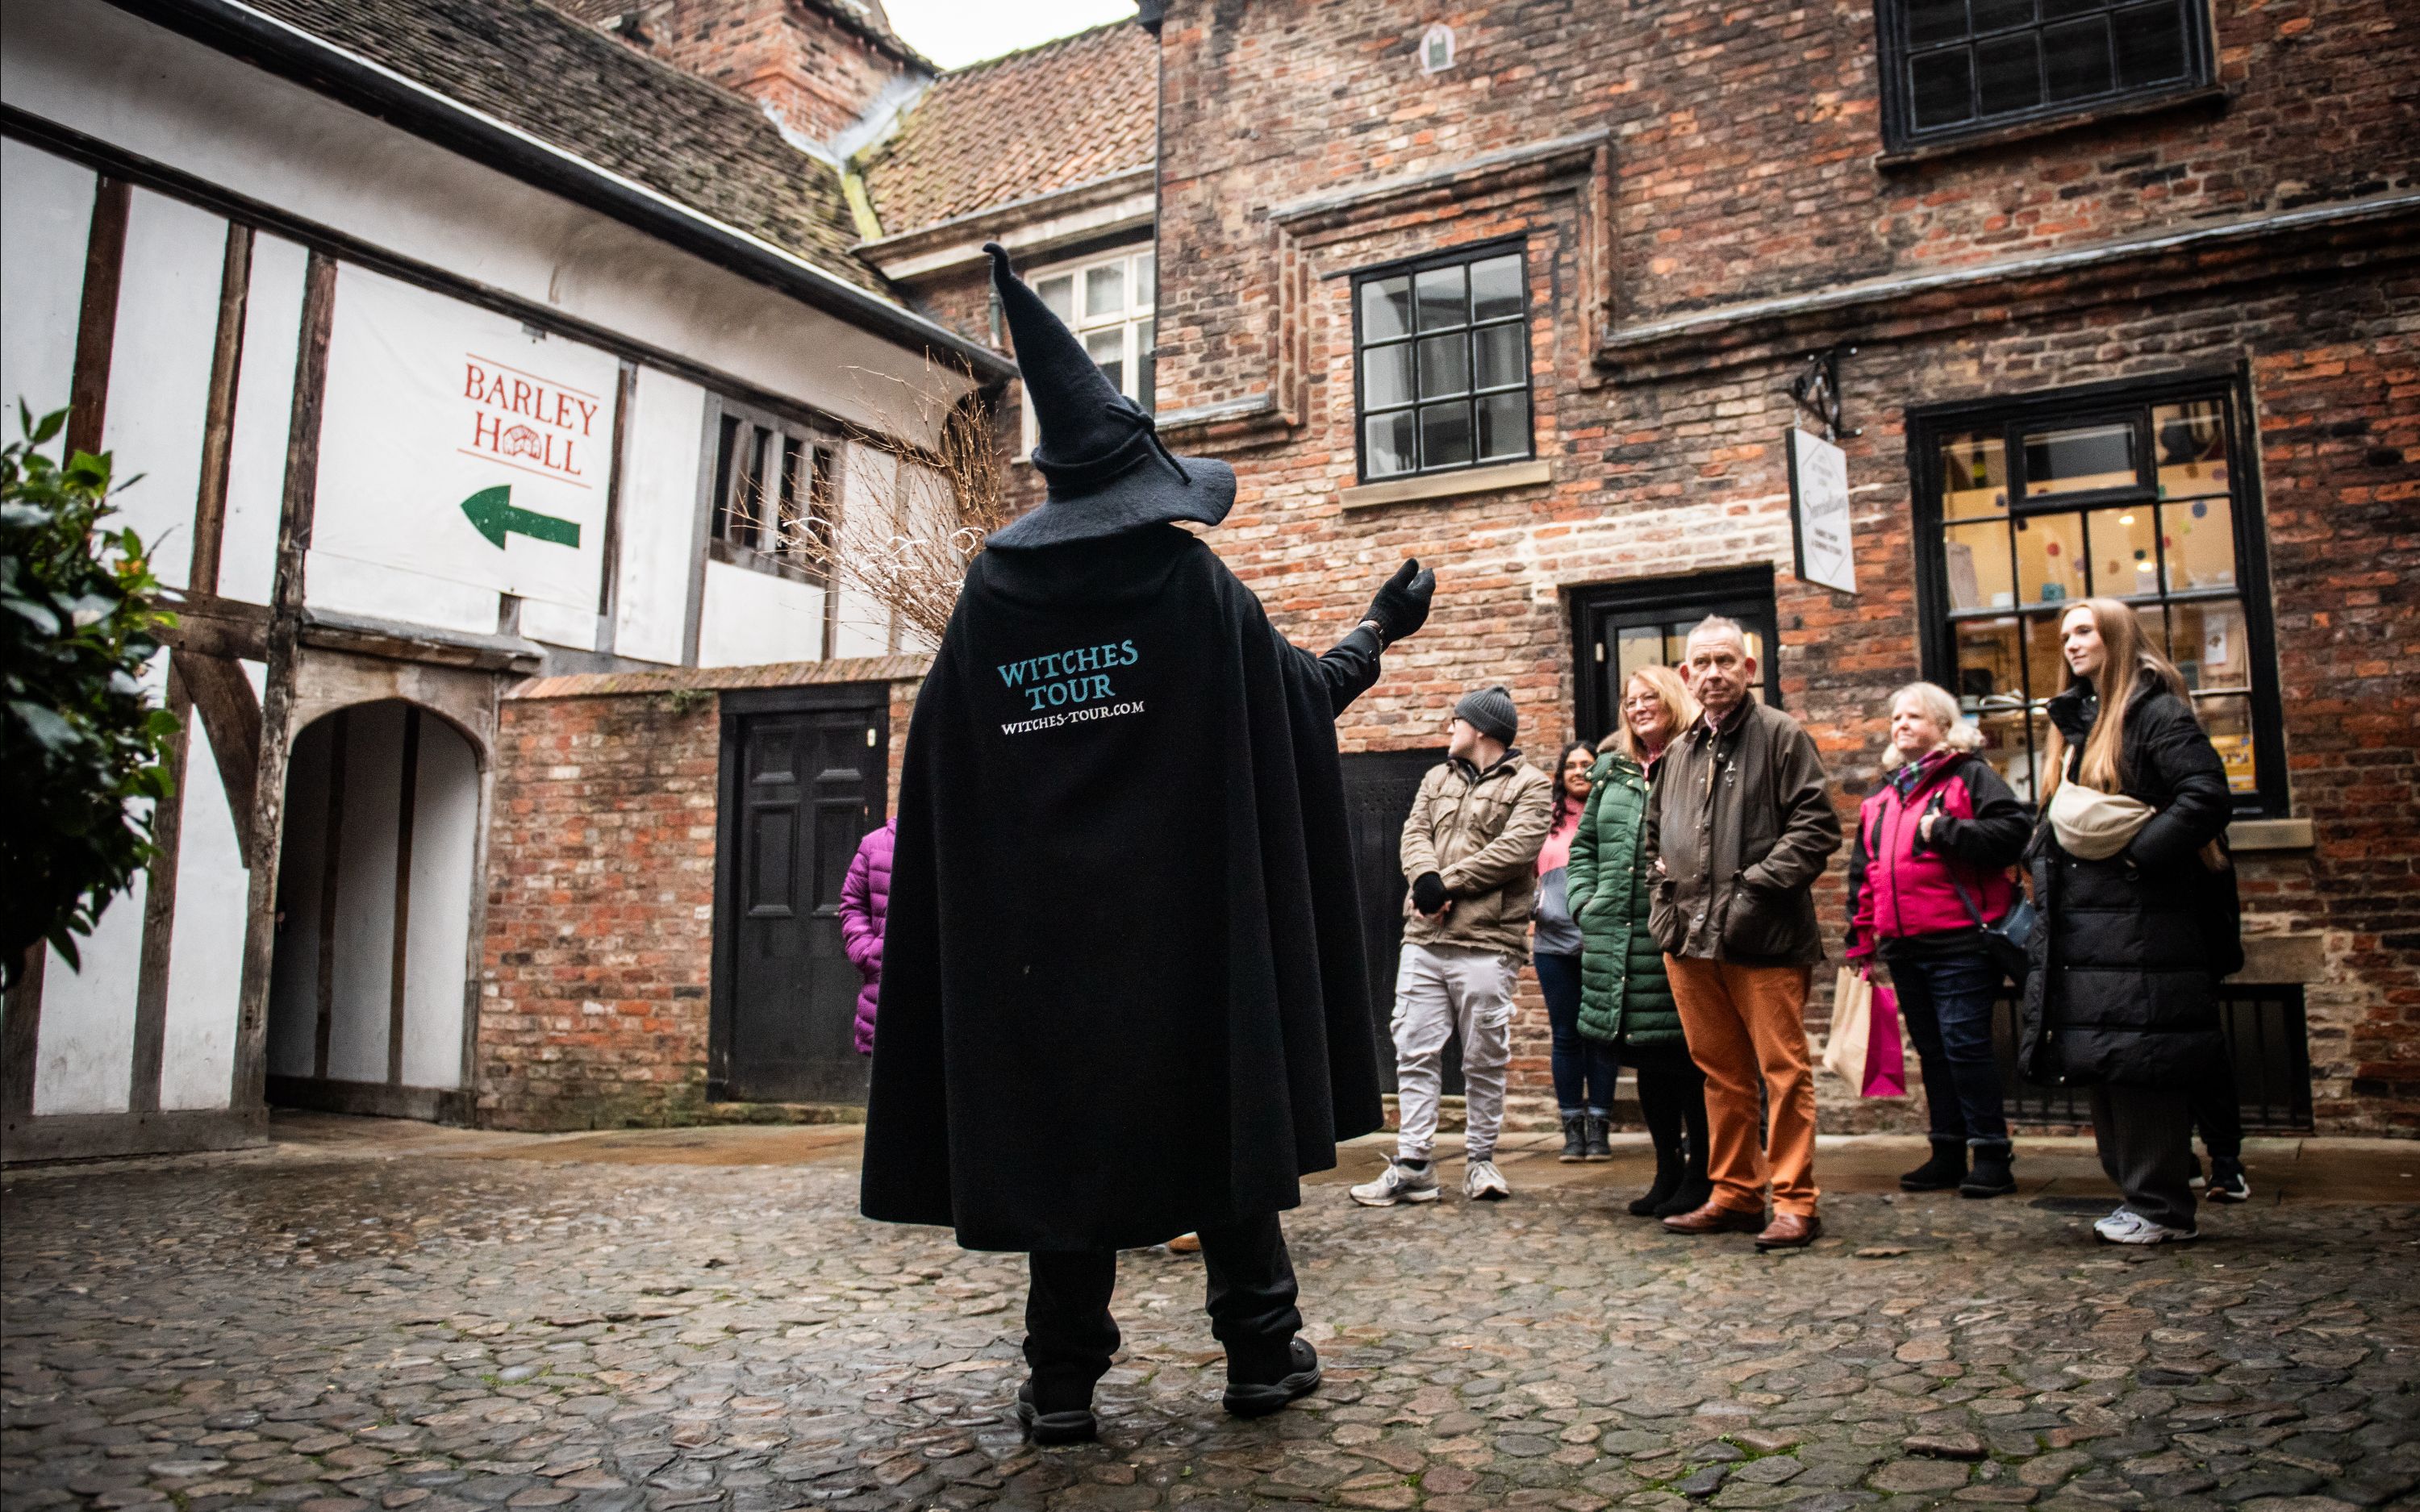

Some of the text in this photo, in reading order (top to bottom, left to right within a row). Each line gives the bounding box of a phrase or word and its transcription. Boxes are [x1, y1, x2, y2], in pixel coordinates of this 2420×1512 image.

[464, 362, 598, 436] BARLEY
[997, 639, 1138, 688] WITCHES
[1024, 673, 1116, 710] TOUR
[1001, 701, 1144, 735] WITCHES-TOUR.COM
